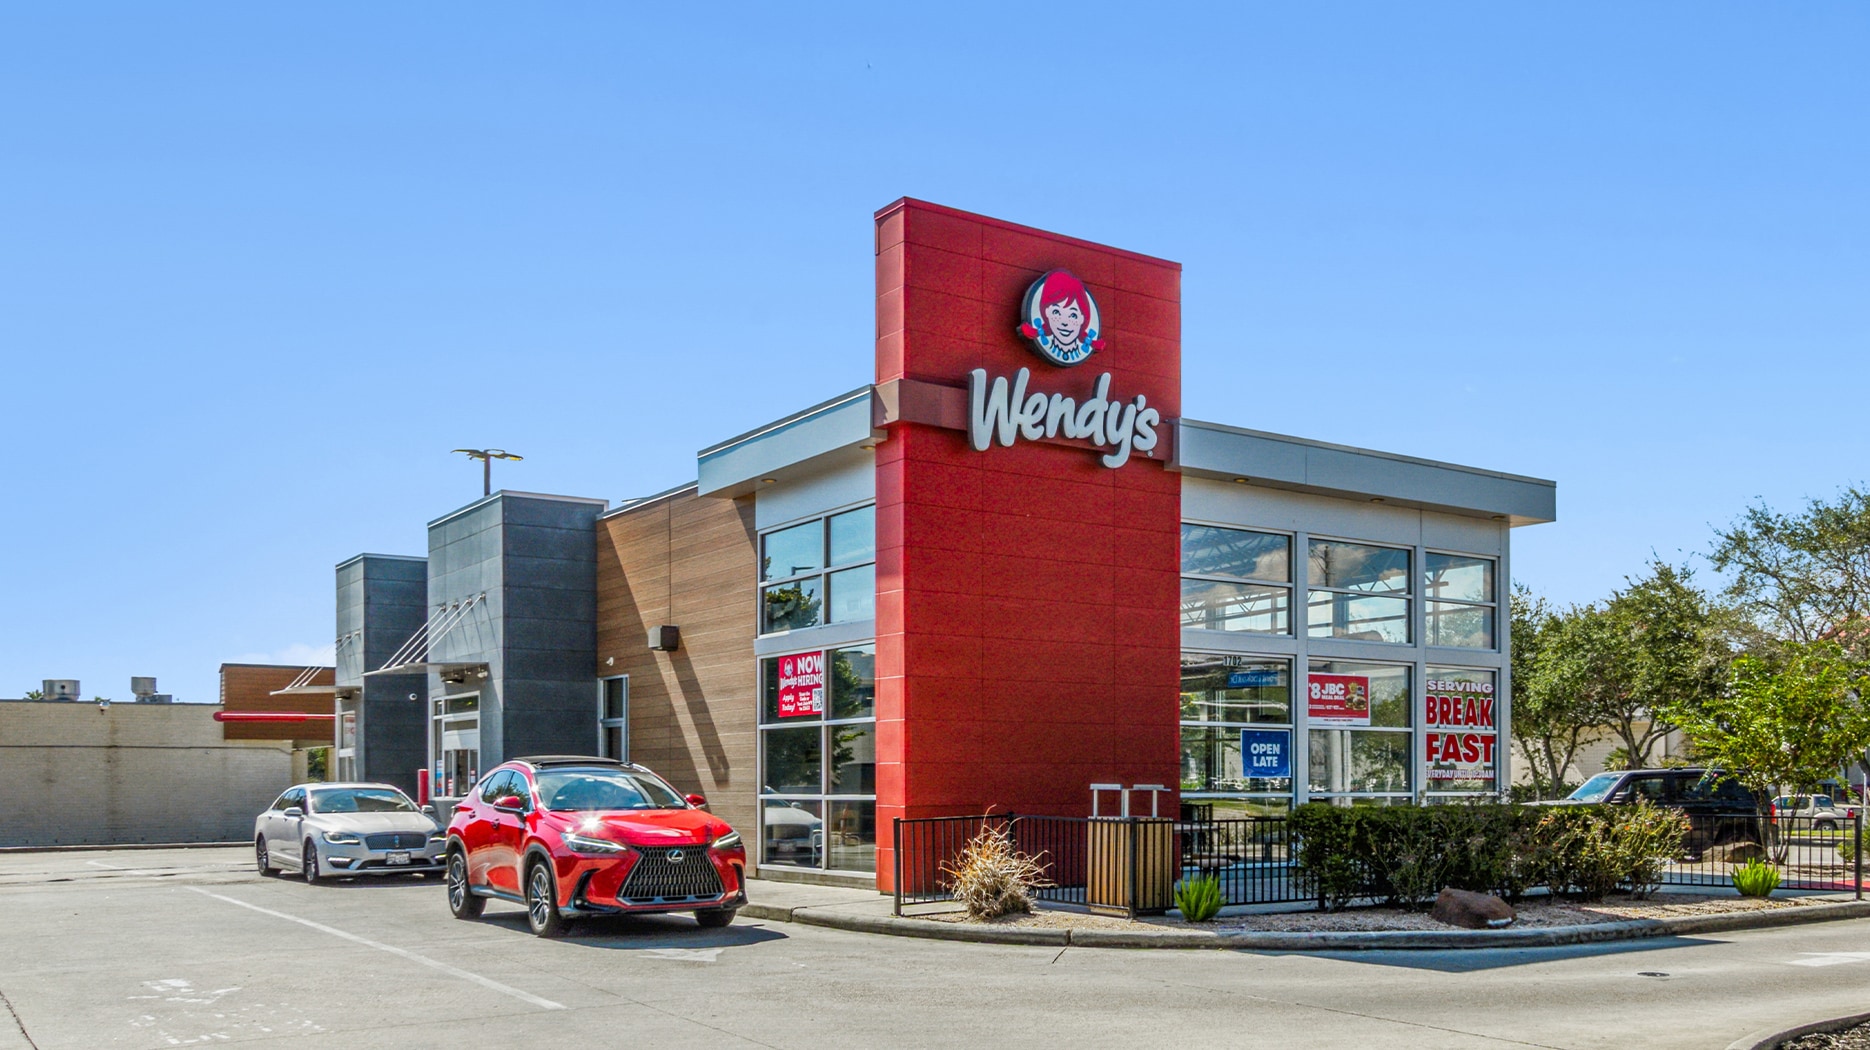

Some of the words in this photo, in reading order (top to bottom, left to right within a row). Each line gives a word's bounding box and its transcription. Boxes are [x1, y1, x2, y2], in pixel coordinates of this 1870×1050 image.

[969, 367, 1160, 469] Wendy's
[797, 655, 822, 674] NOW
[1223, 656, 1242, 666] 1702
[1321, 683, 1345, 695] JBC
[1427, 680, 1494, 693] SERVING
[1426, 695, 1494, 728] BREAK
[1250, 743, 1280, 755] OPEN
[1426, 733, 1496, 766] FAST
[1253, 756, 1278, 767] LATE
